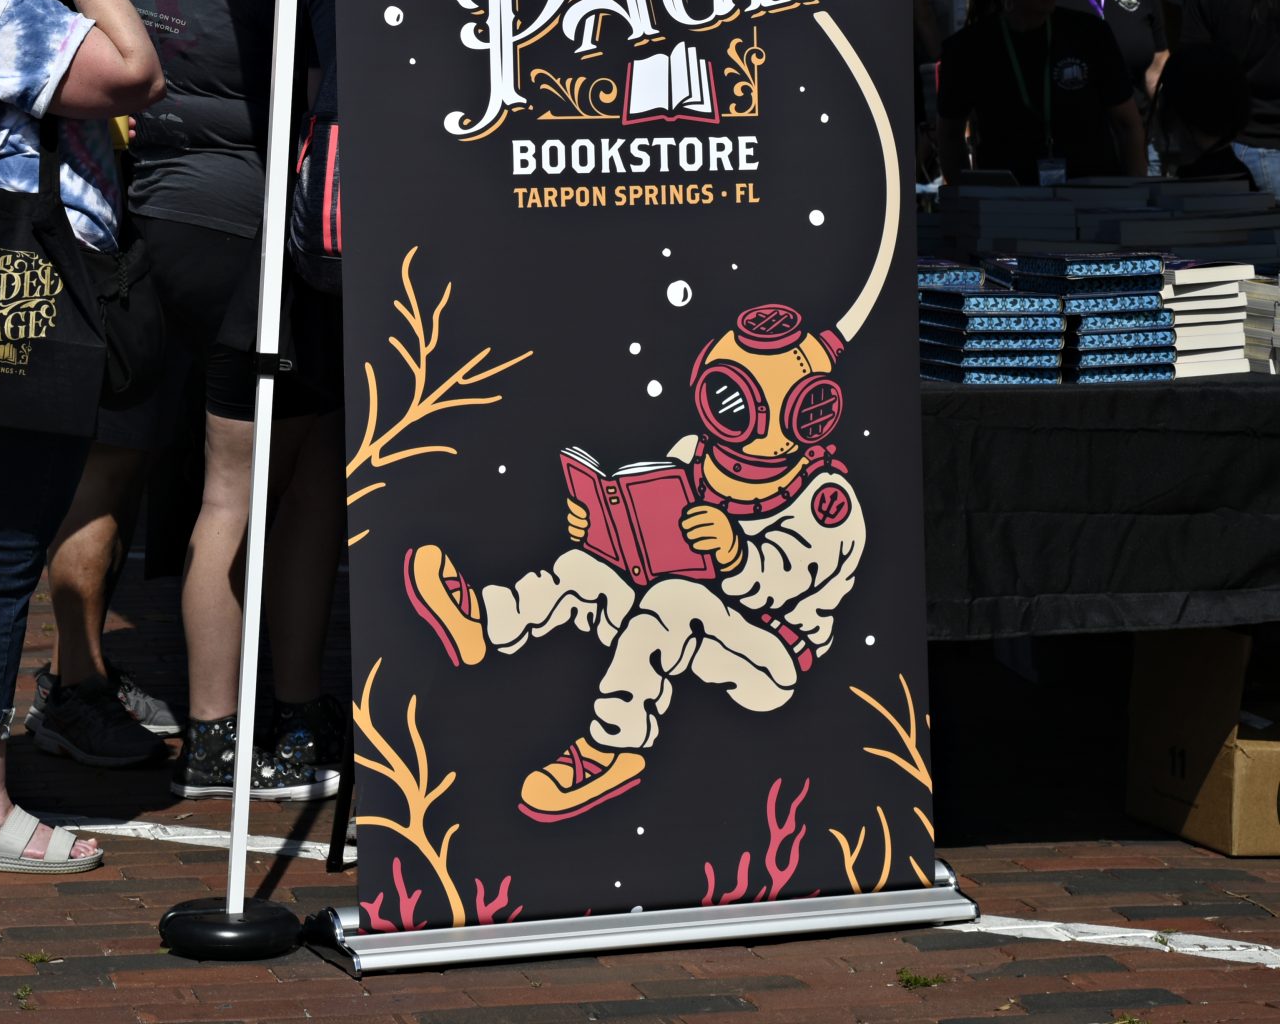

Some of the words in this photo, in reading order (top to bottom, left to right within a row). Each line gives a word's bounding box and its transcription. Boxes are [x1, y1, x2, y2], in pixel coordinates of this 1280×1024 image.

[154, 22, 180, 34] WORLD
[171, 17, 187, 26] YOU
[511, 135, 760, 176] BOOKSTORE
[513, 186, 607, 209] TARPON
[614, 183, 714, 207] SPRINGS
[735, 182, 761, 204] FL
